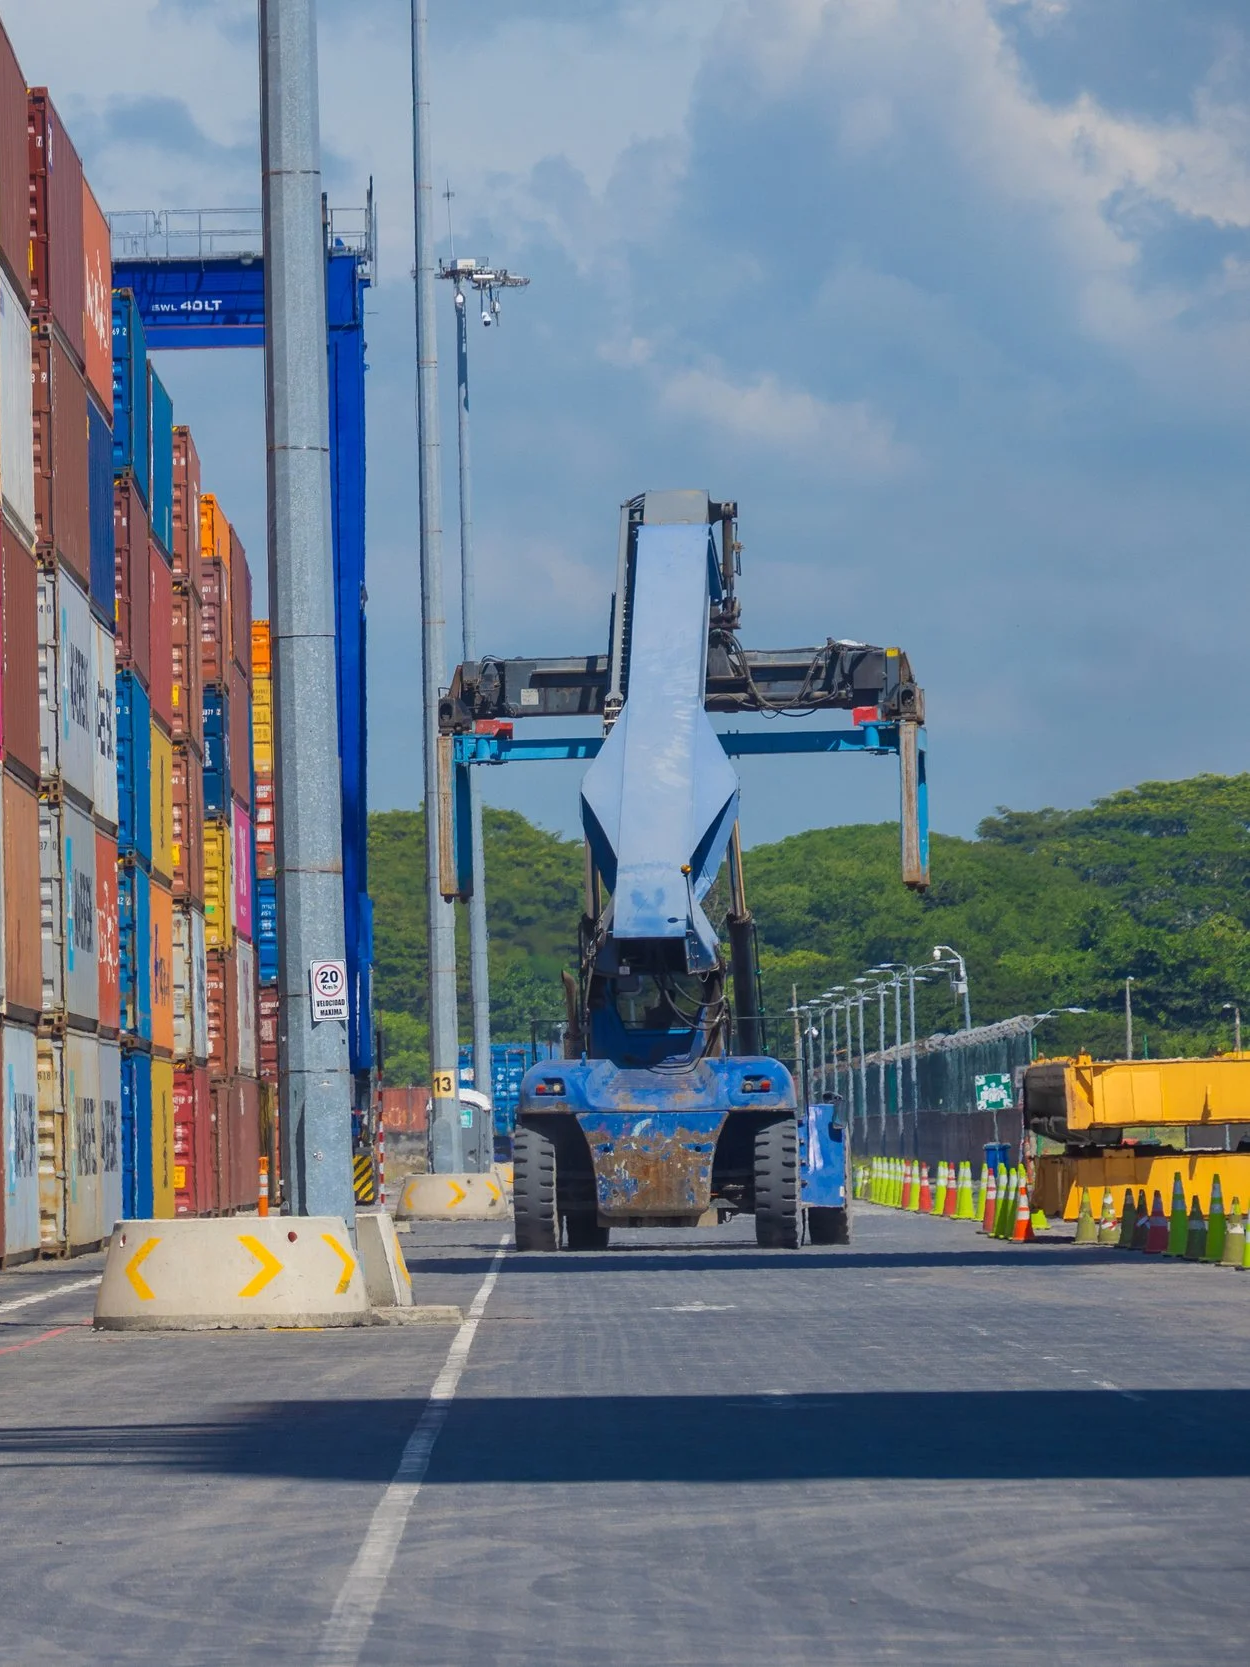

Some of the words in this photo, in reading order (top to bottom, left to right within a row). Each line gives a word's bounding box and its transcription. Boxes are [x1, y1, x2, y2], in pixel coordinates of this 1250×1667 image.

[180, 299, 223, 311] 40LT
[320, 971, 338, 983] 20
[316, 999, 346, 1007] VELOCIDAD
[320, 1008, 342, 1016] MAXIMA
[434, 1077, 451, 1092] 13
